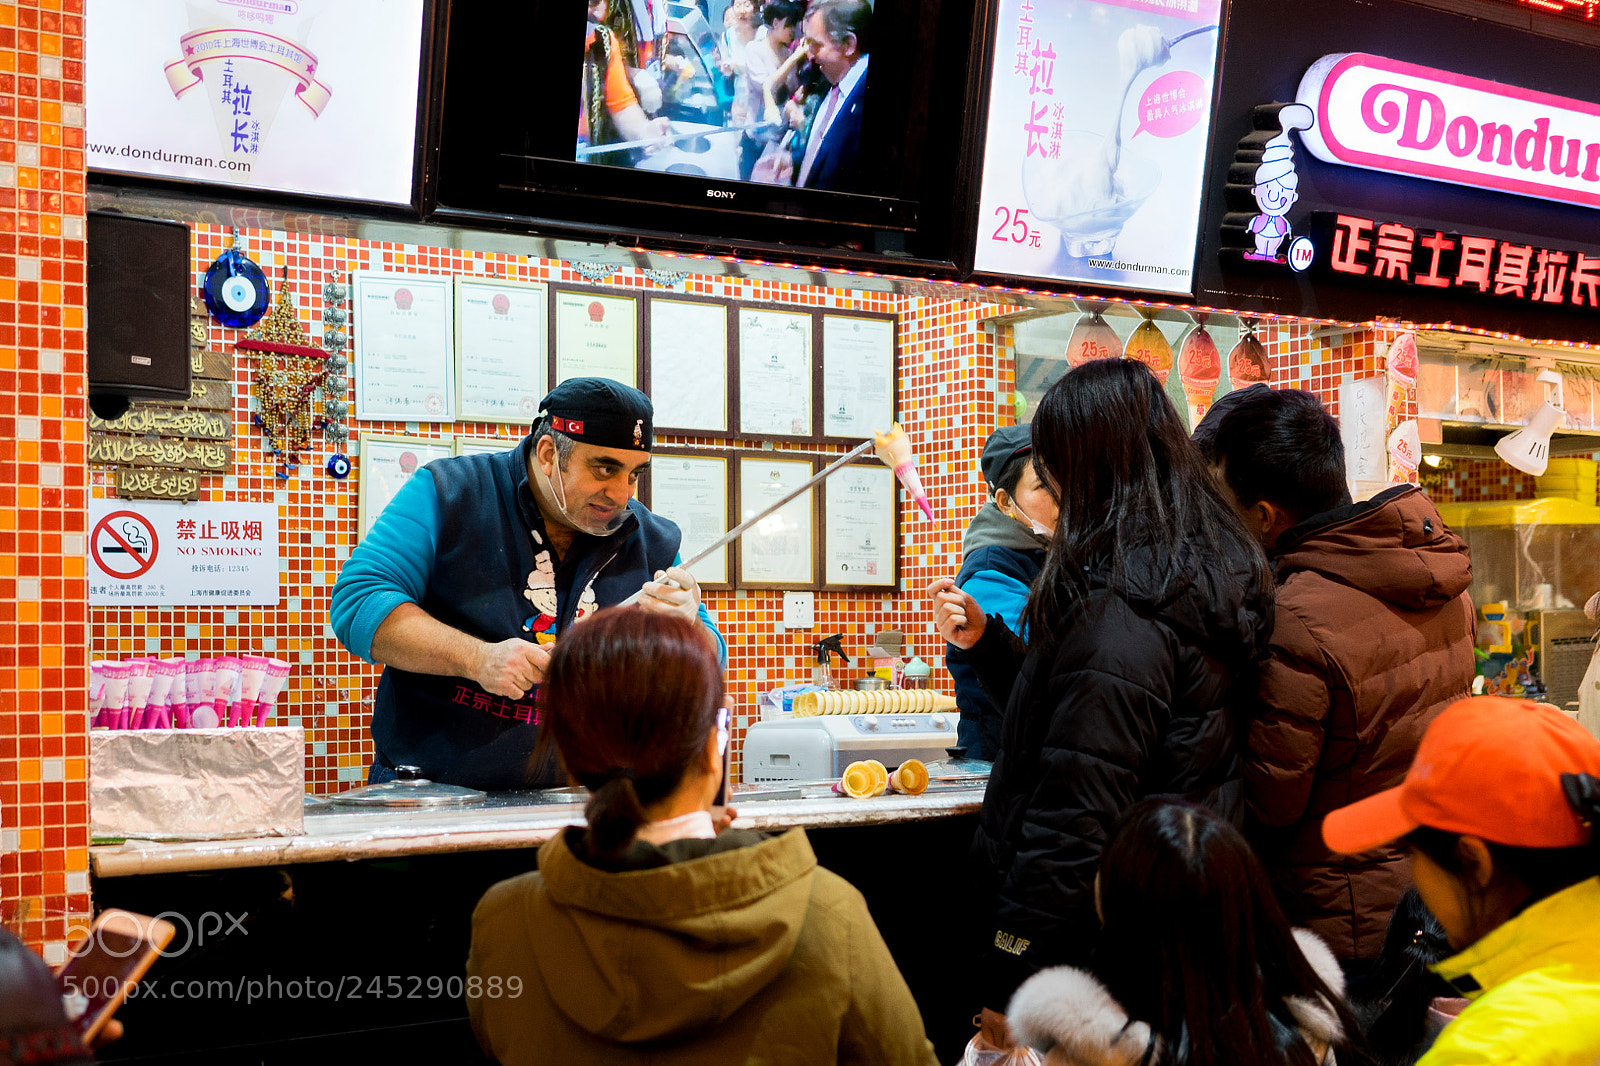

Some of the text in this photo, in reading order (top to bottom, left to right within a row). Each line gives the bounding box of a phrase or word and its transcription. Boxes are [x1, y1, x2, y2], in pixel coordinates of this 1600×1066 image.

[221, 58, 234, 104] 土耳其
[1023, 38, 1056, 159] 拉长
[231, 82, 252, 153] 拉长
[250, 120, 260, 154] 冰淇淋
[1048, 101, 1065, 159] 冰淇淋
[86, 143, 251, 172] ww.dondurman.com
[707, 189, 736, 199] SONY
[992, 206, 1041, 248] 25元
[1088, 258, 1190, 277] www.dondurman.com
[1330, 214, 1600, 307] 正宗土耳其拉长
[1081, 341, 1109, 358] 25元
[1137, 348, 1161, 367] 25元
[1189, 349, 1212, 368] 25元
[1396, 348, 1412, 368] 25元
[1238, 358, 1260, 377] 25元
[1396, 438, 1413, 460] 25元
[176, 519, 263, 541] 禁止吸烟
[177, 547, 262, 557] NO SMOKING
